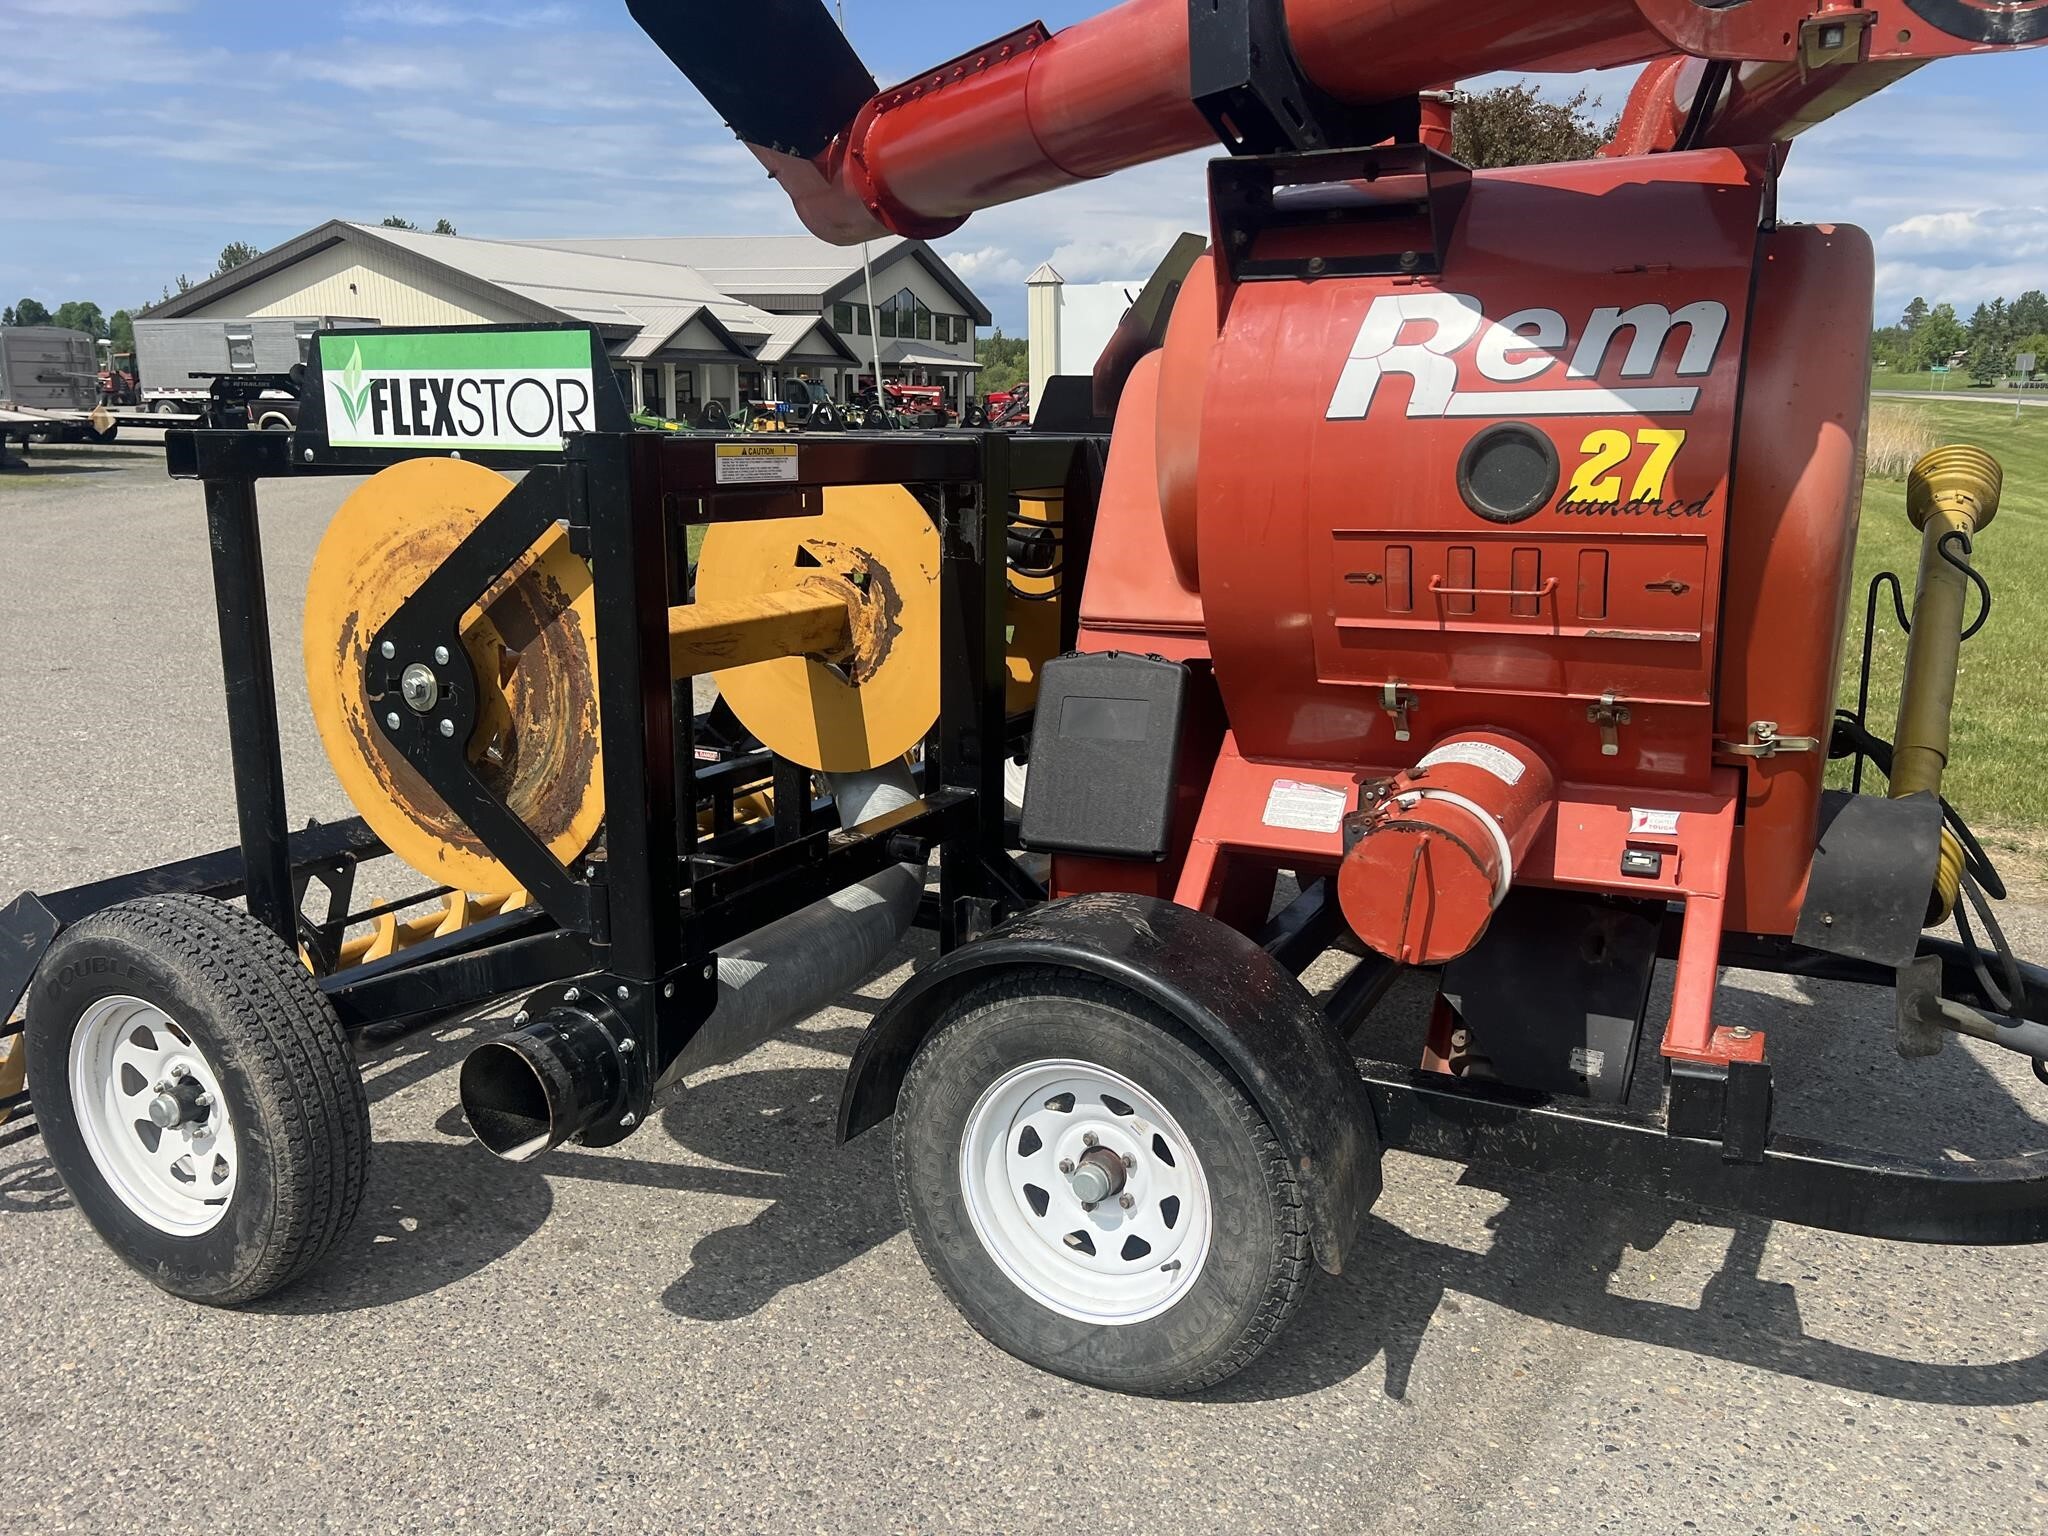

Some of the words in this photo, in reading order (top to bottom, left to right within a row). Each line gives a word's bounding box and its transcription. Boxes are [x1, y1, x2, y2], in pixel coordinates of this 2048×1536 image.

[1326, 292, 1729, 419] Rem
[370, 378, 588, 437] FLEXSTOR
[748, 447, 775, 456] CAUTION
[1568, 428, 1686, 505] 27
[1556, 486, 1713, 519] hundred
